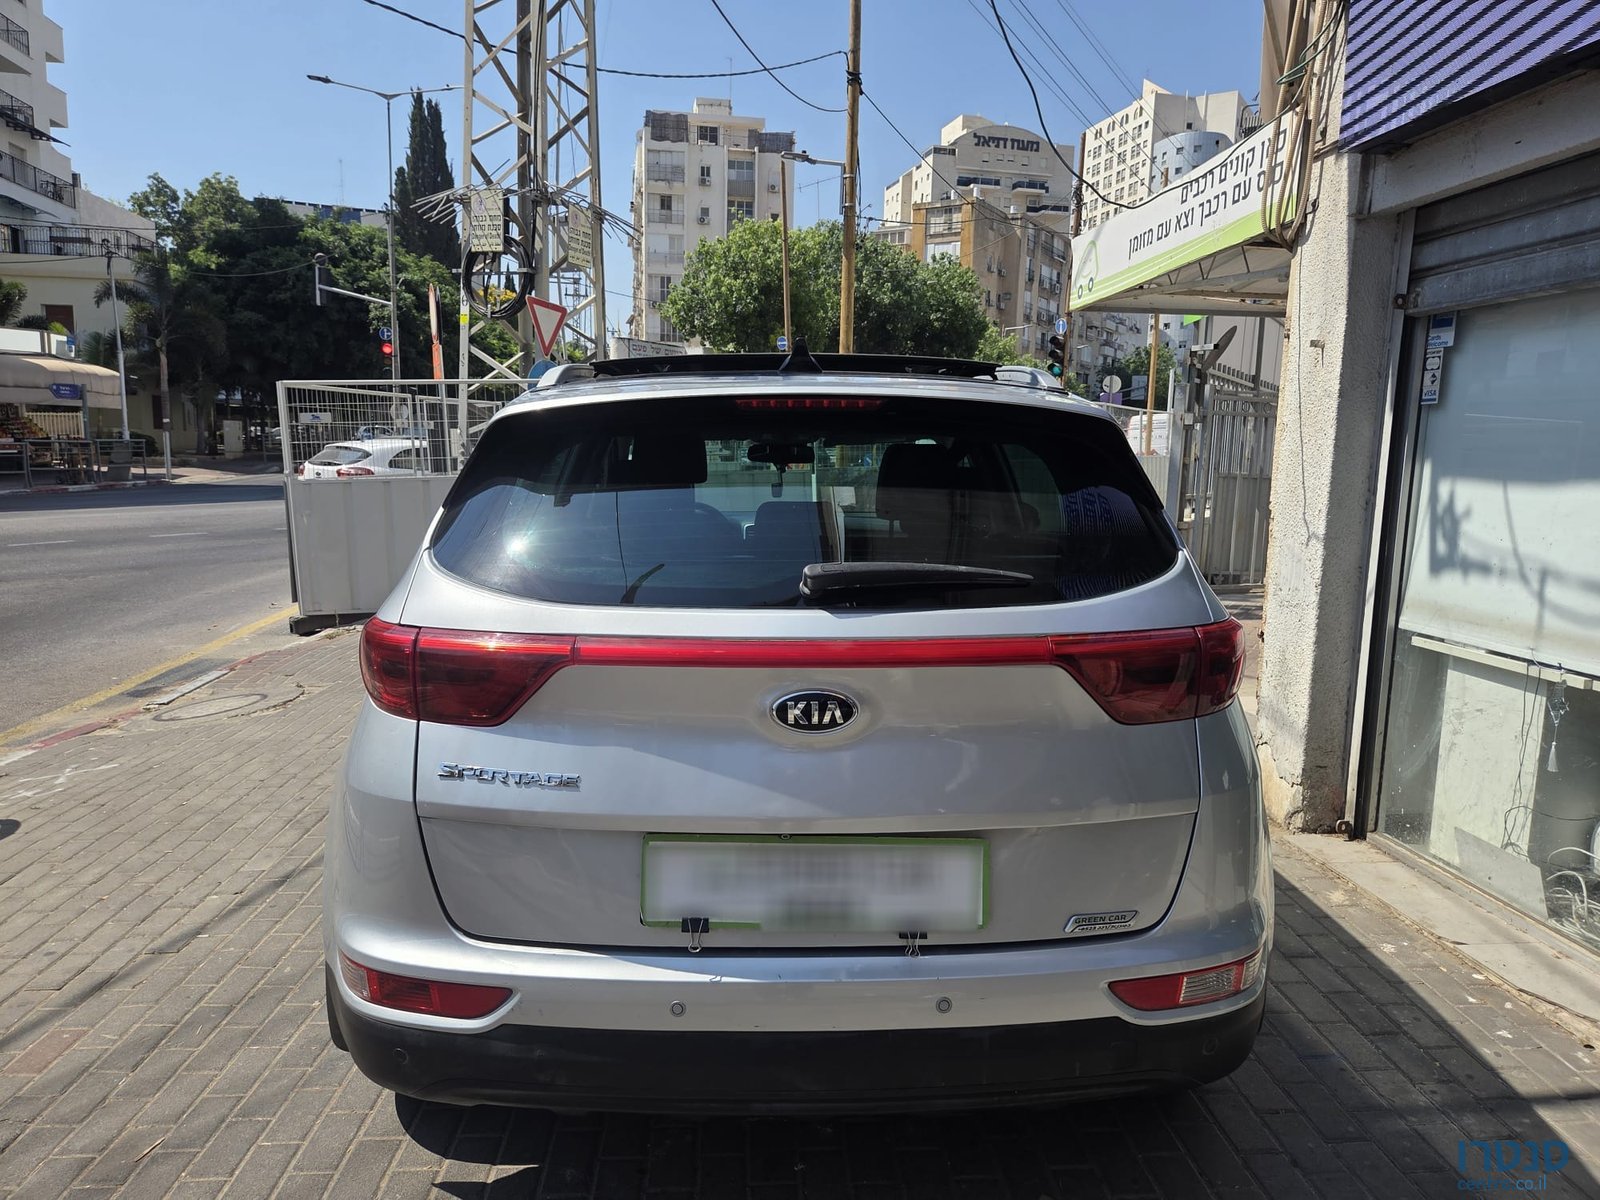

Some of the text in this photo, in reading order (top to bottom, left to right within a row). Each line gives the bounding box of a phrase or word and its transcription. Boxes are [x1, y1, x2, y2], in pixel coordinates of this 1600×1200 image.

[973, 132, 1008, 149] דניאל
[1219, 146, 1256, 184] קונים
[1180, 168, 1215, 204] רכבים
[1128, 160, 1284, 260] כס עם רכבך וצא עם מזומן
[1423, 389, 1437, 397] VISA
[787, 700, 845, 727] KIA
[437, 761, 582, 791] SPORTAGE
[1074, 914, 1127, 924] GREEN CAR
